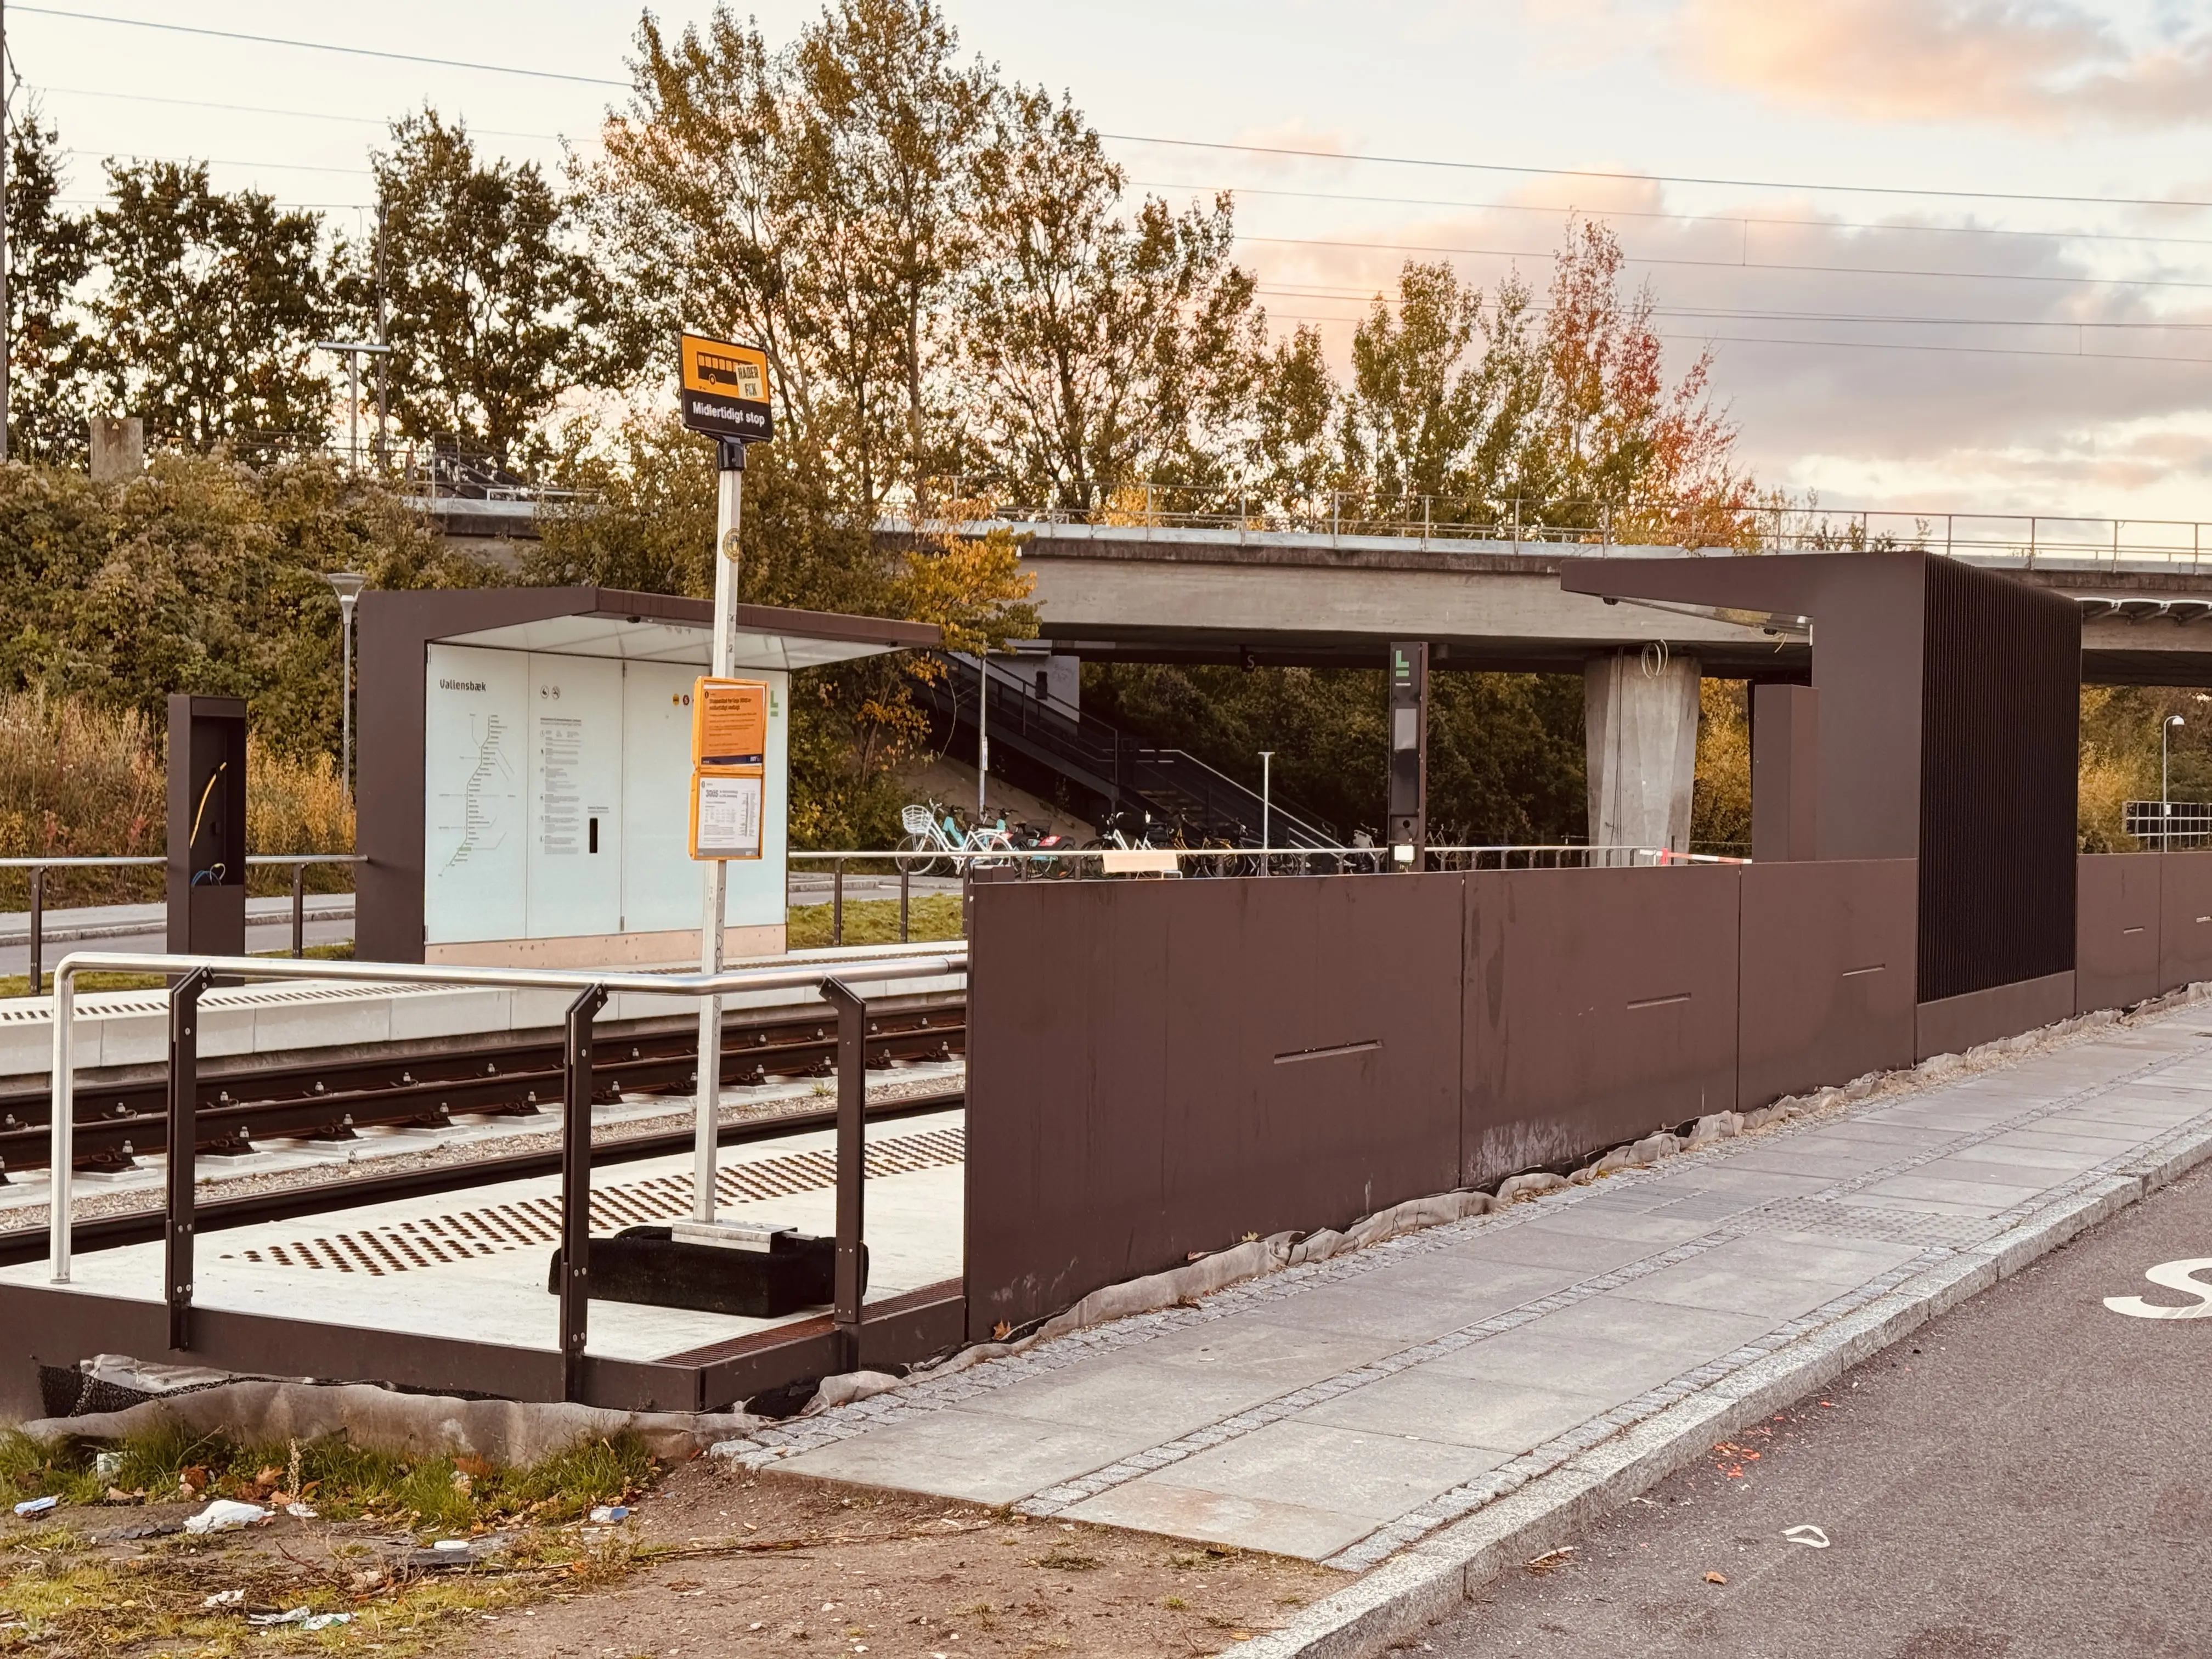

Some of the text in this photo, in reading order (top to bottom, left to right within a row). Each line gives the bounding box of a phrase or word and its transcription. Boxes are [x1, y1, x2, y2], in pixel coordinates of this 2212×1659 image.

[693, 402, 765, 427] Midlertidigt stop
[1247, 654, 1255, 669] S
[439, 679, 486, 691] Vallensbæk
